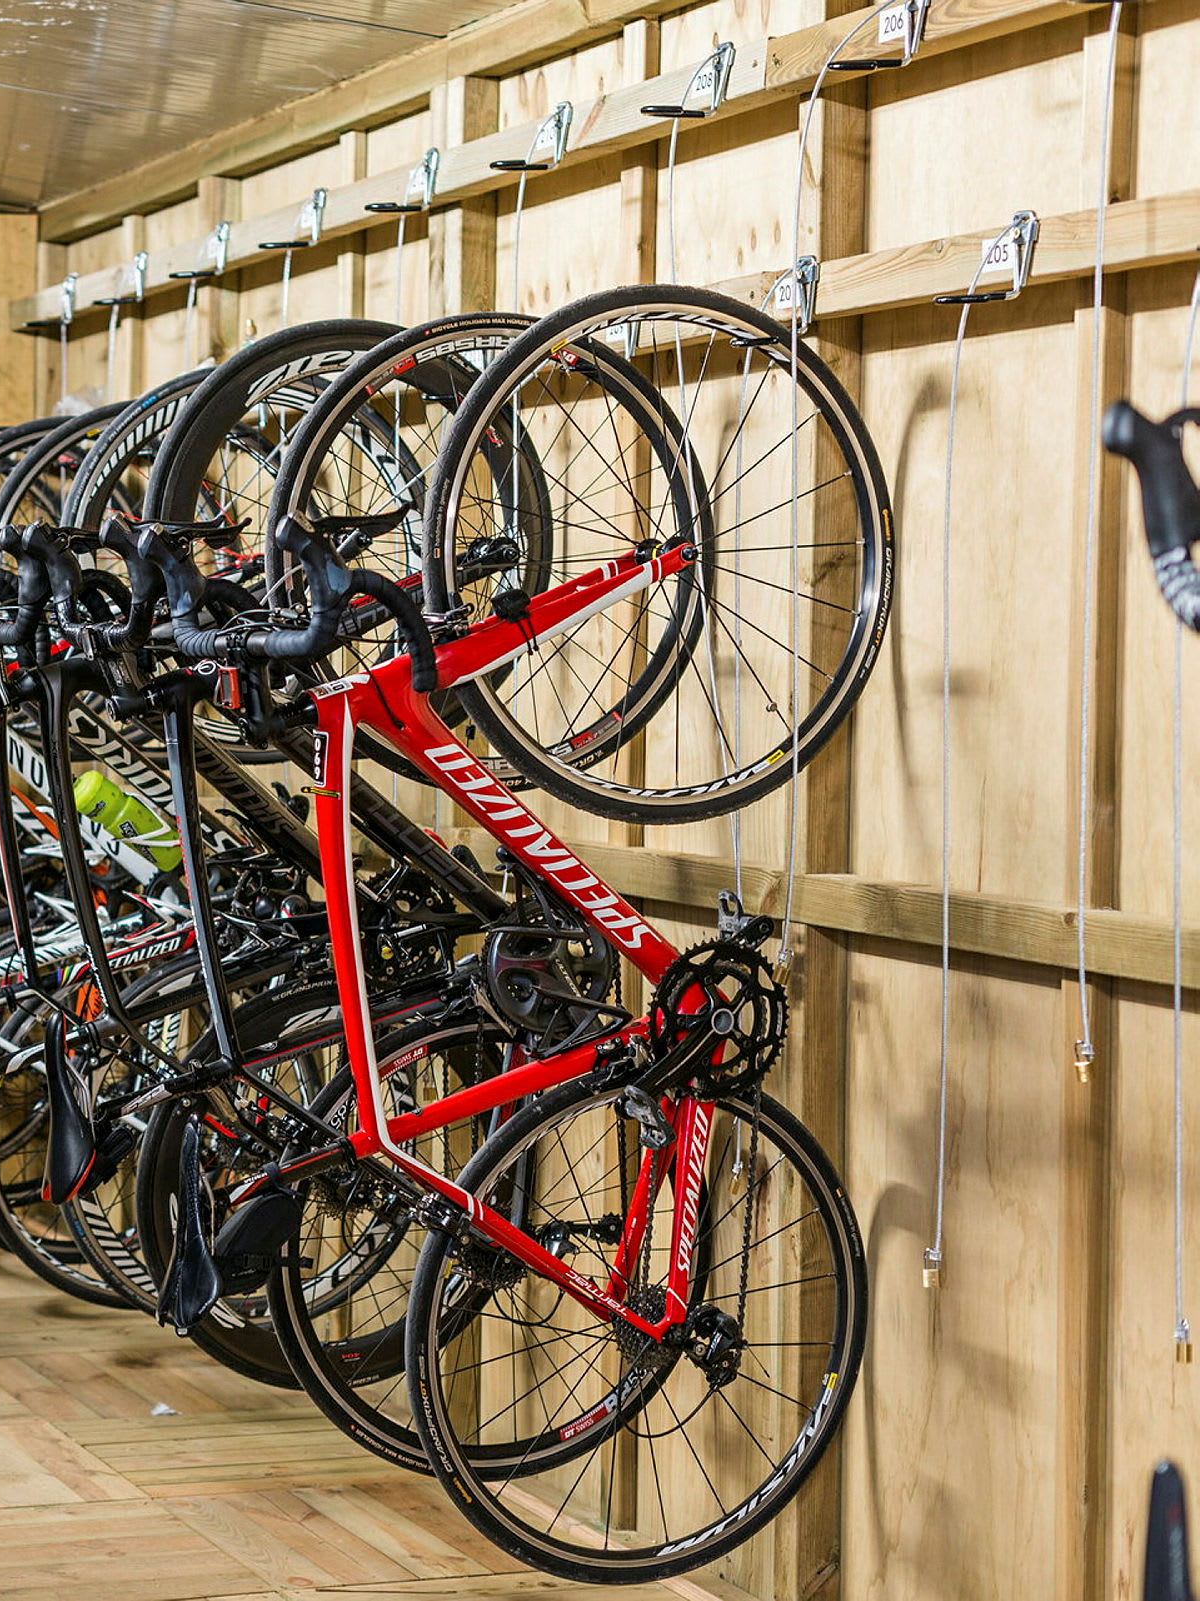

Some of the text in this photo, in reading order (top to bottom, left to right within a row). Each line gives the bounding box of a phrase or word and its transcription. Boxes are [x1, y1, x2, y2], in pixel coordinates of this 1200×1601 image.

[883, 12, 904, 34] 206
[986, 244, 1009, 265] 205
[779, 284, 793, 302] 20
[313, 738, 321, 780] 069
[423, 742, 664, 951] SPECIALIZED
[108, 936, 180, 969] ECIALIZED
[676, 1104, 712, 1273] SPECIALIZED
